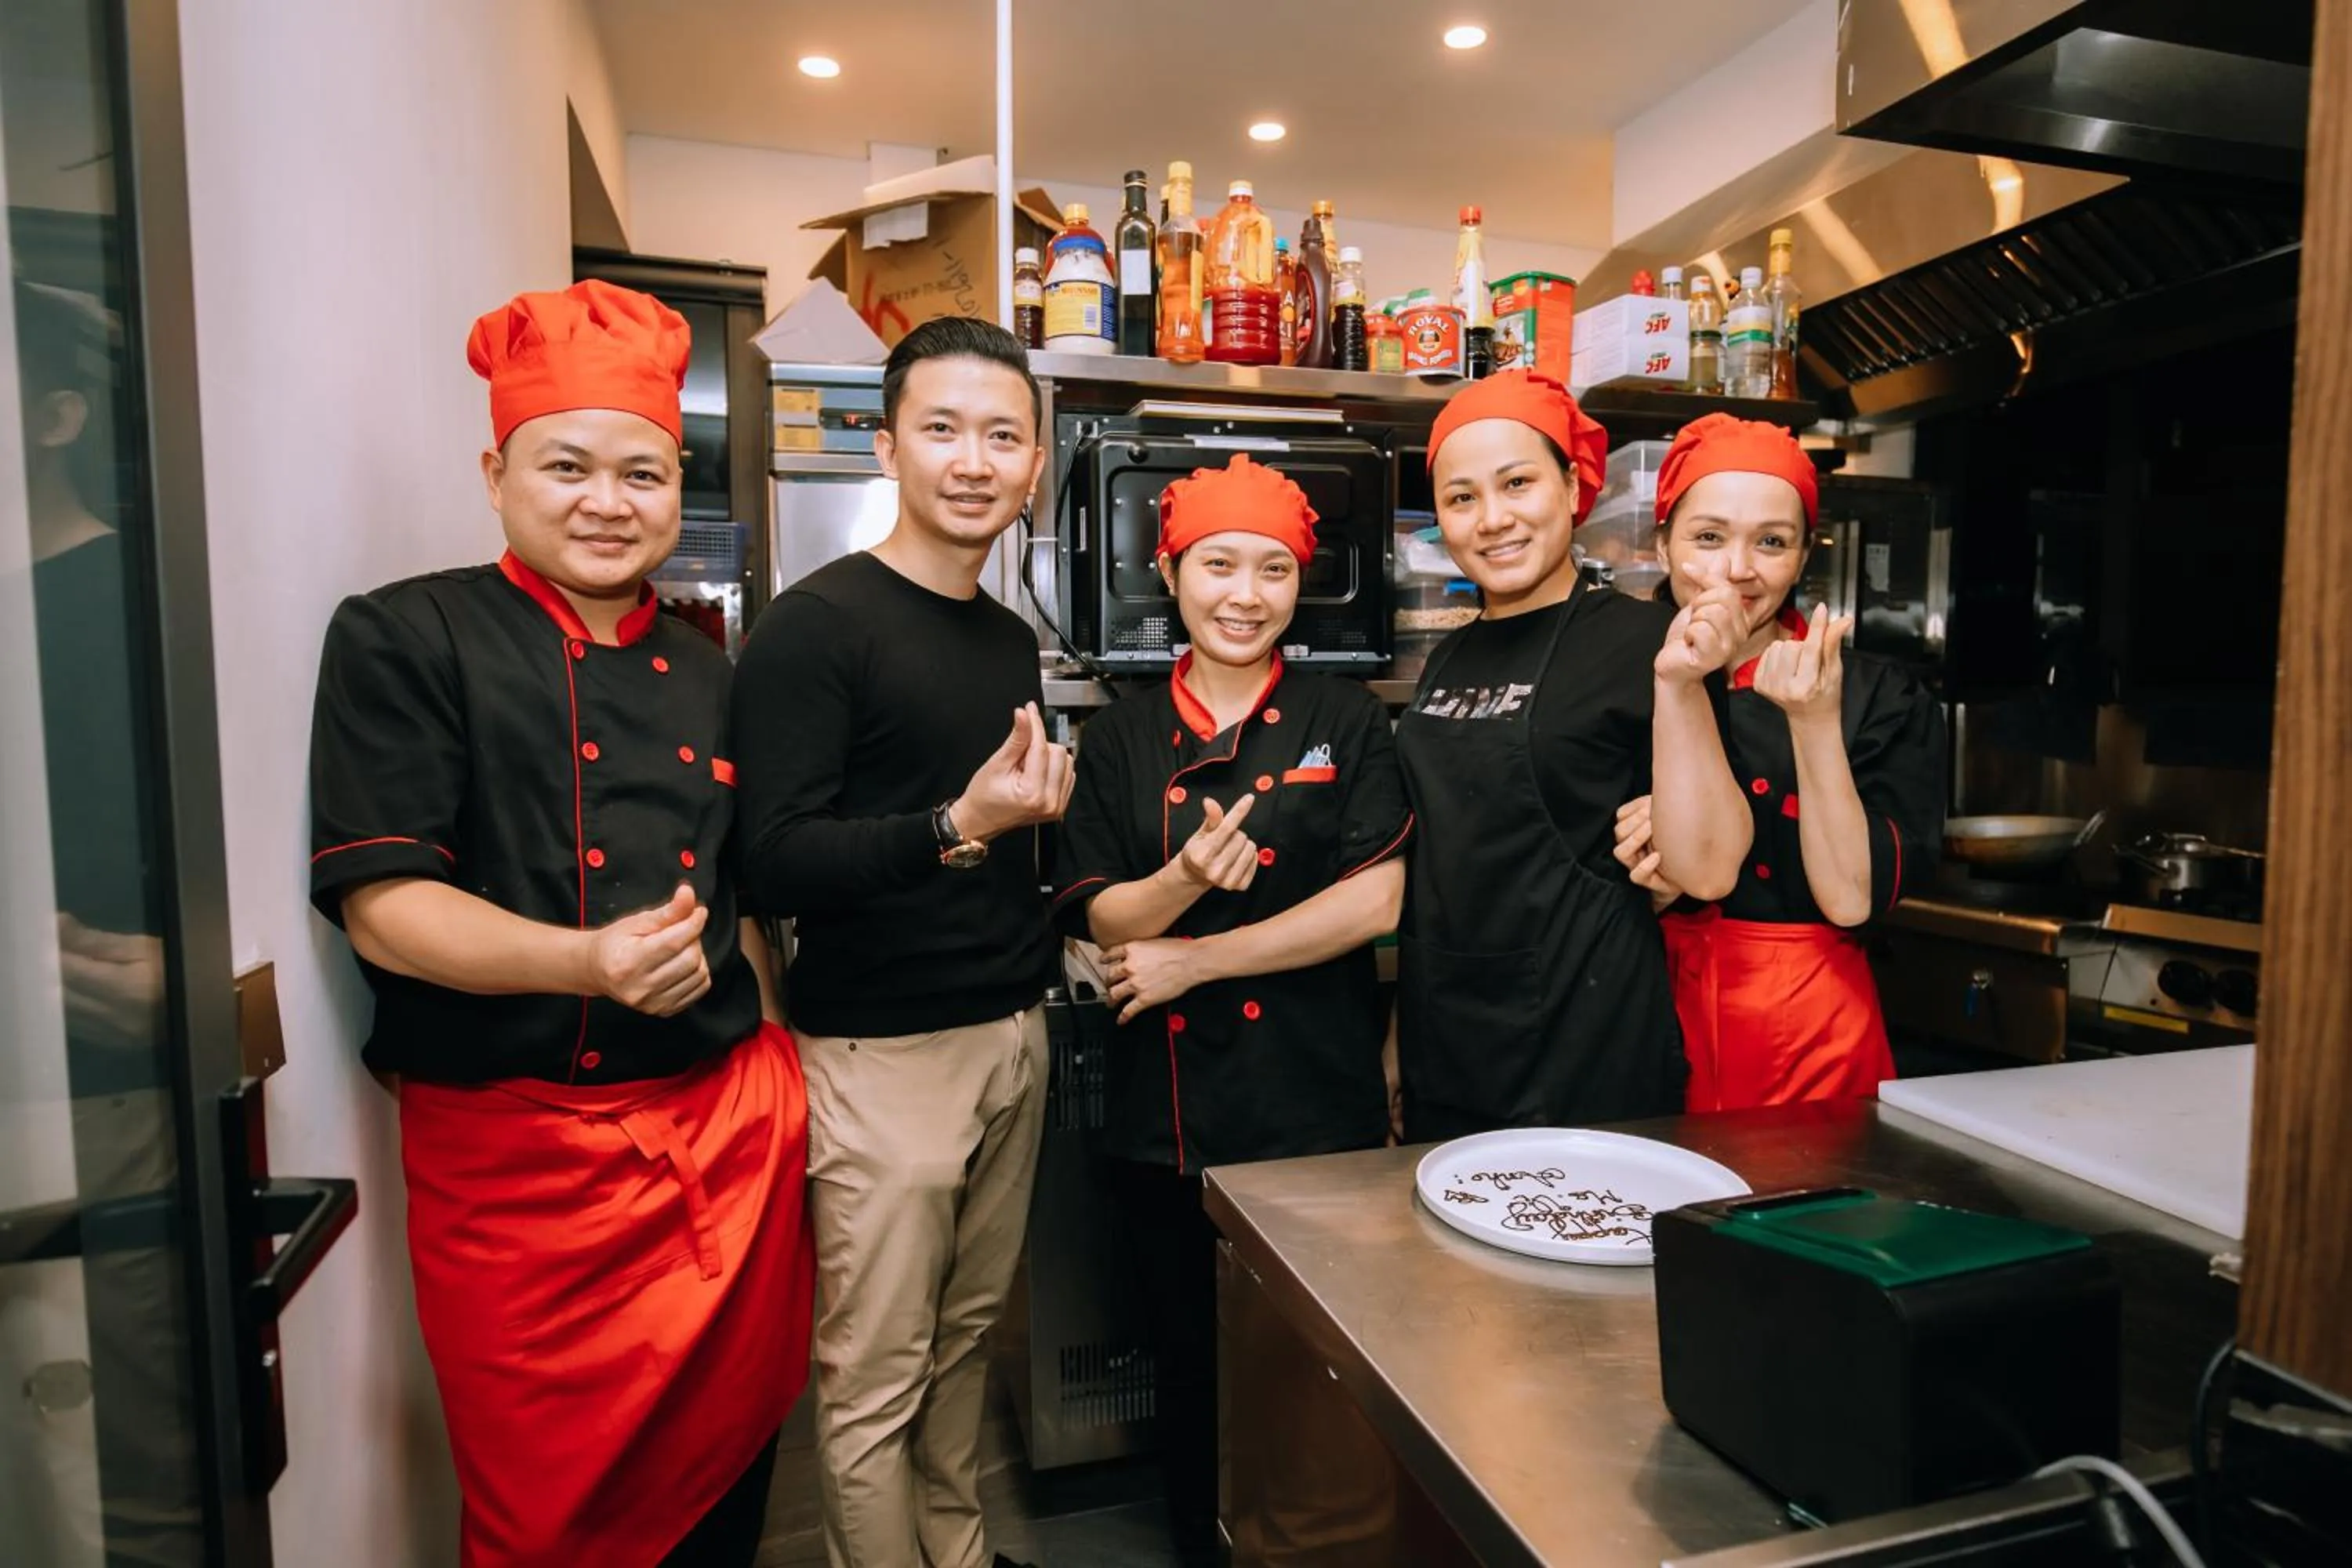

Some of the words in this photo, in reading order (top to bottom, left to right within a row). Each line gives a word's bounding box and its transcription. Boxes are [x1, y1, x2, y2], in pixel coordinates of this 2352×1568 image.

[1408, 315, 1450, 336] ROYAL
[1645, 317, 1671, 334] AFC
[1645, 357, 1671, 374] AFC
